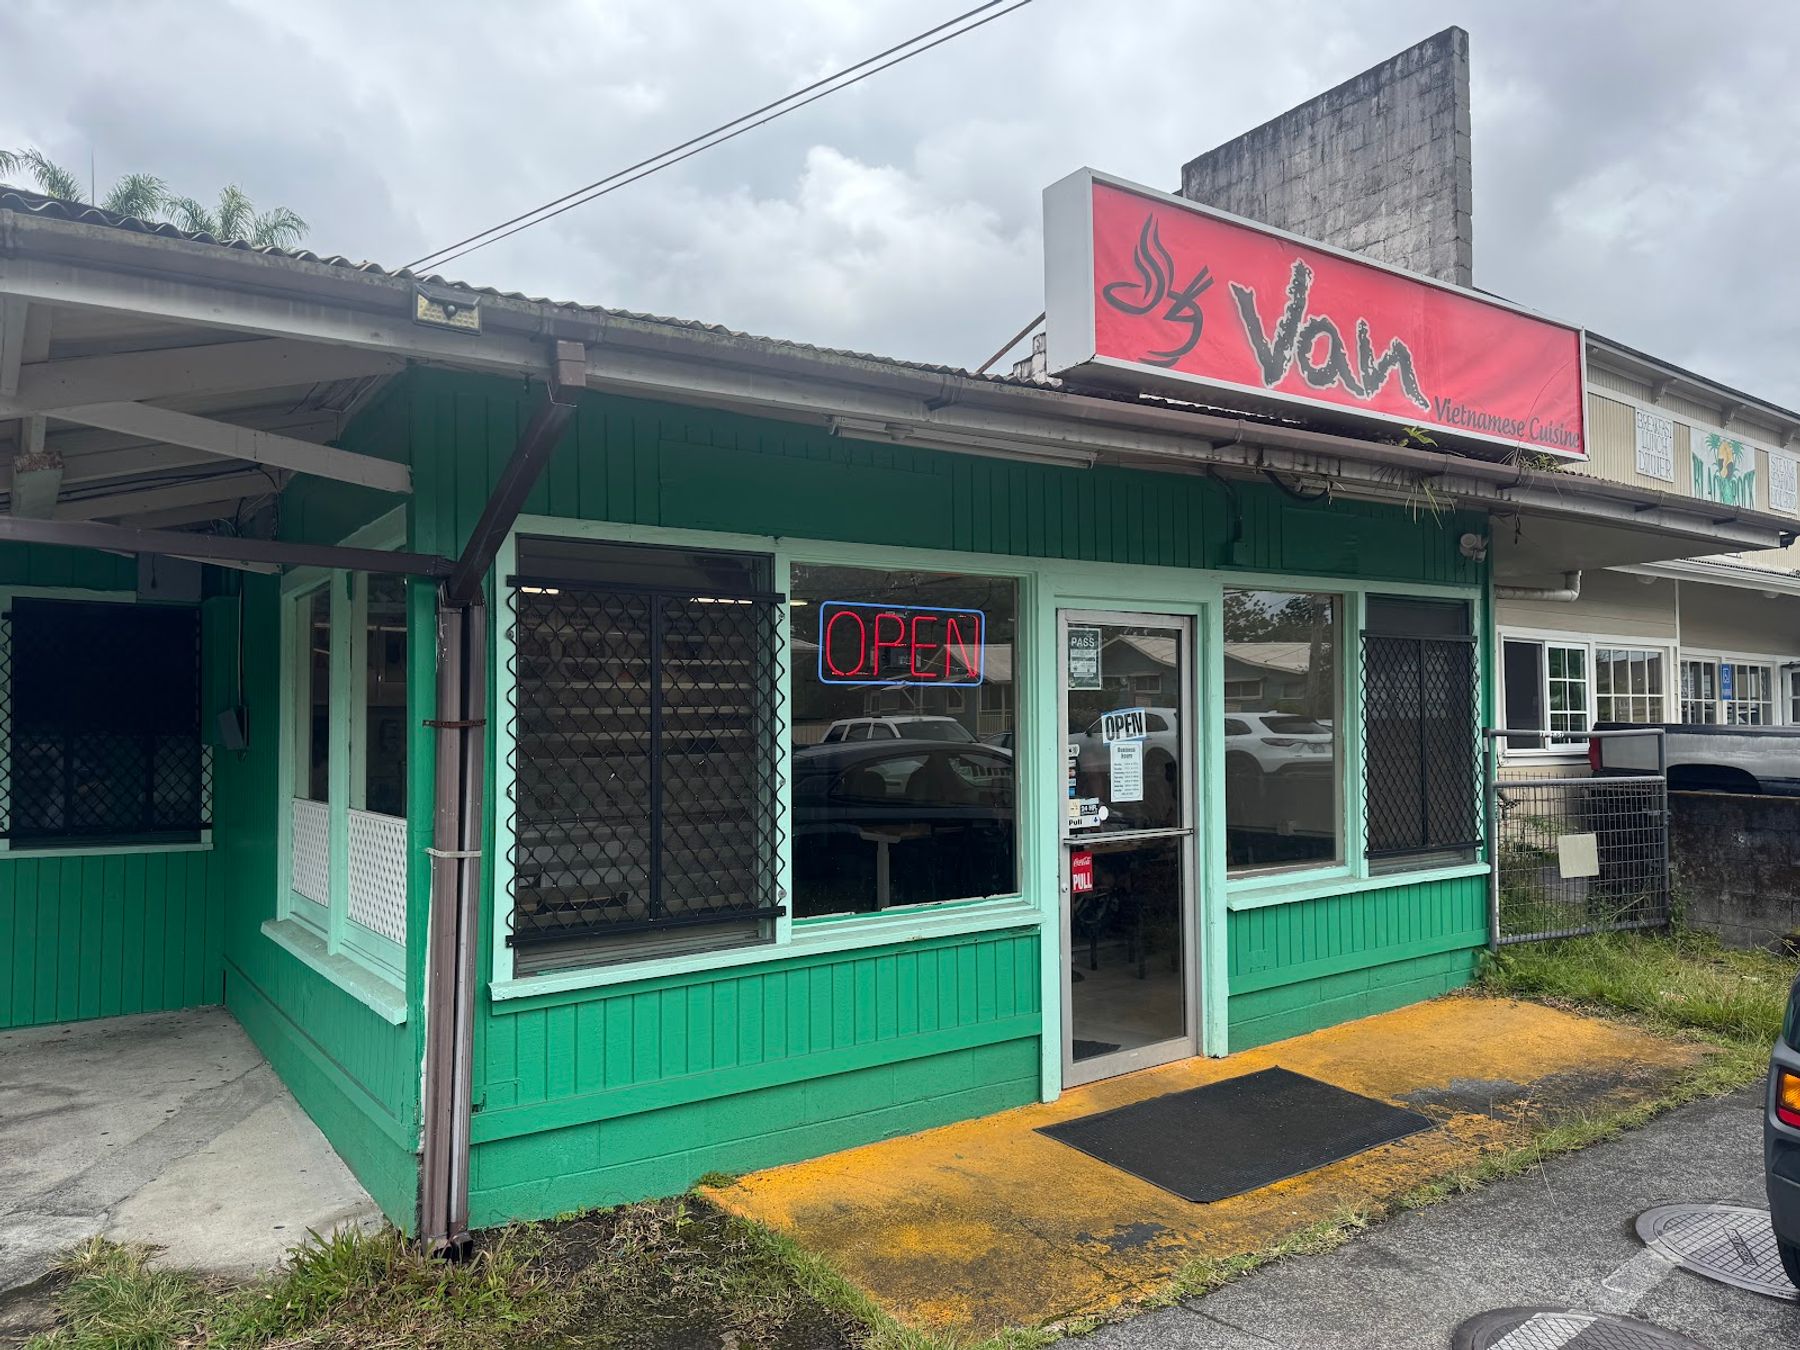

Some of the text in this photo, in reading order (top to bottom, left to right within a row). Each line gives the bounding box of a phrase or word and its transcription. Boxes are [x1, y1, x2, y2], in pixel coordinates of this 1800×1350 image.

[1228, 259, 1430, 411] Van
[1434, 396, 1580, 448] Vietnamese Cuisine
[825, 610, 980, 679] OPEN
[1071, 637, 1095, 647] PASS
[1105, 712, 1143, 741] OPEN
[1069, 818, 1083, 826] Pull
[1072, 872, 1093, 891] PULL
